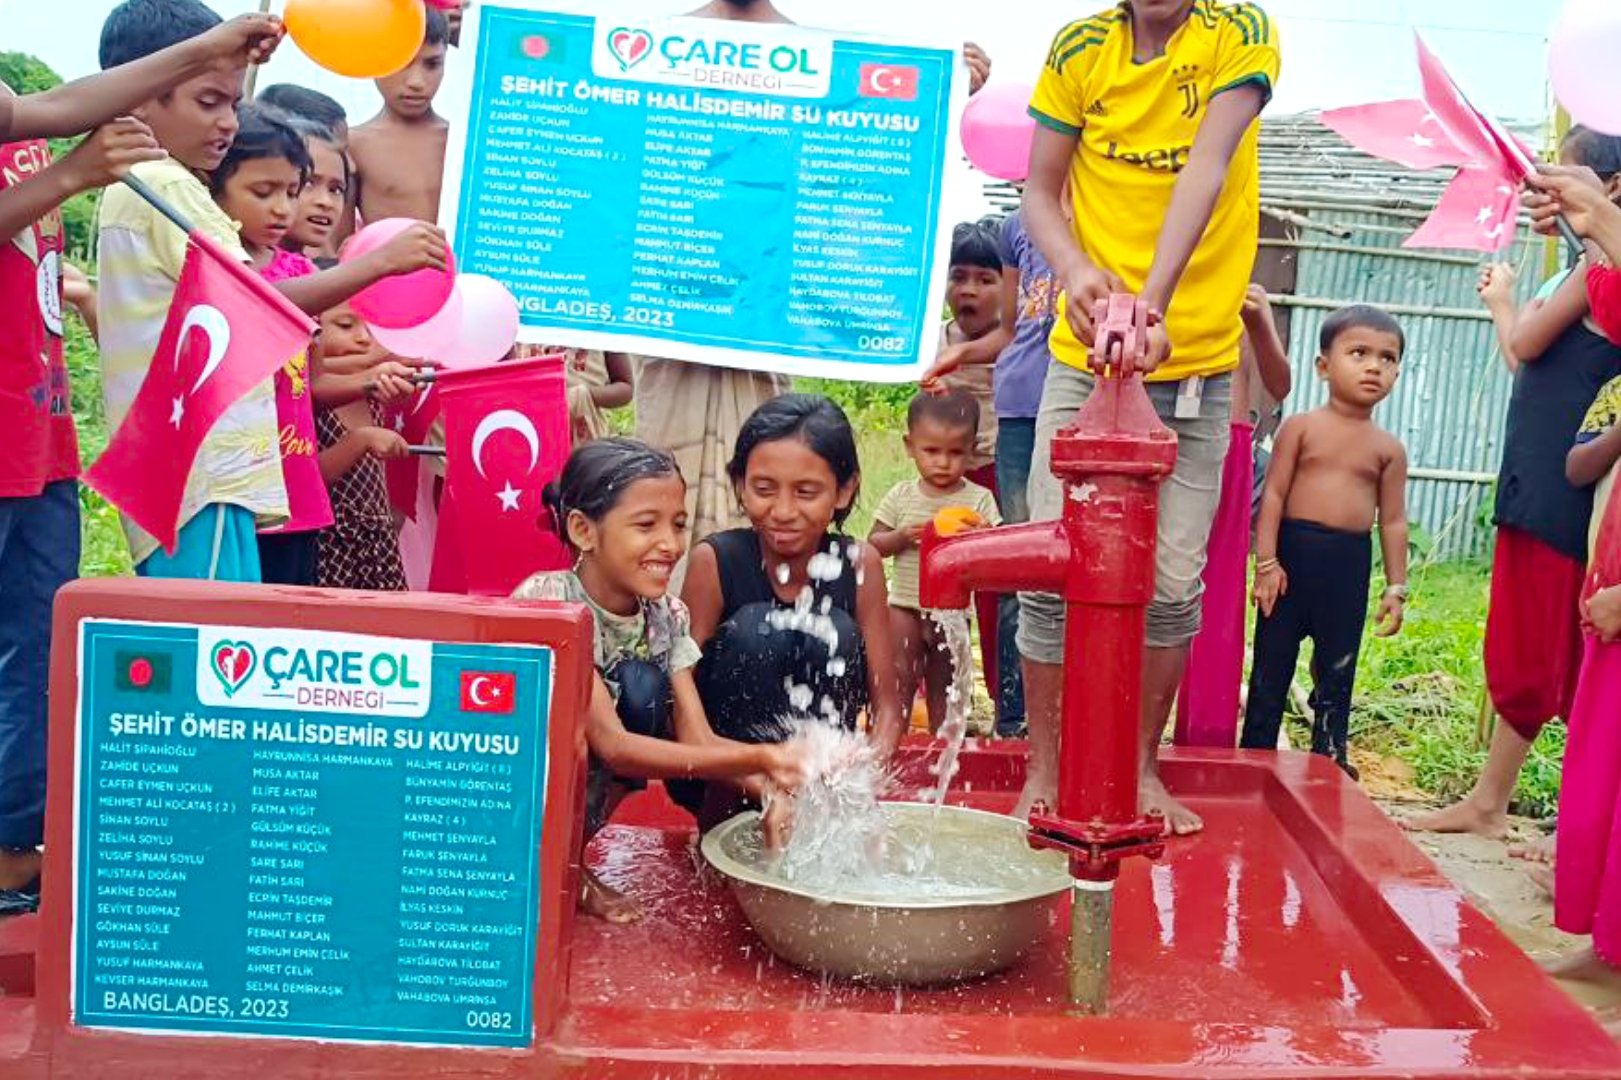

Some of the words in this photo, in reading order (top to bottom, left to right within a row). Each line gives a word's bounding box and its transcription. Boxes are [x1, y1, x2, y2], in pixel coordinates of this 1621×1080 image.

[660, 36, 762, 69] ÇARE
[769, 46, 818, 75] OL
[501, 74, 568, 97] ŞEHİT
[573, 81, 640, 106] ÖMER
[647, 89, 785, 121] HALİSDEMİR
[790, 105, 821, 124] SU
[826, 111, 920, 132] KUYUSU
[518, 296, 617, 323] NGLADEŞ,
[623, 306, 675, 327] 2023
[858, 335, 905, 351] 0082
[263, 646, 363, 689] ÇARE
[369, 652, 420, 688] OL
[109, 711, 175, 736] ŞEHİT
[181, 713, 246, 740] ÖMER
[253, 718, 388, 748] HALİSDEMİR
[394, 730, 423, 749] SU
[429, 730, 520, 755] KUYUSU
[322, 754, 393, 767] HARMANKAYA
[253, 768, 282, 779] MUSA
[284, 770, 319, 780] AKTAR
[99, 778, 135, 789] CAFER
[137, 779, 173, 791] EYMEN
[283, 788, 317, 798] AKTAR
[99, 796, 142, 808] MEHMET
[145, 797, 162, 808] ALİ
[251, 803, 286, 815] FATMA
[134, 816, 169, 826] SOYLU
[404, 813, 444, 824] KAYRAZ
[138, 834, 173, 845] SOYLU
[403, 831, 444, 842] MEHMET
[99, 850, 133, 860] YUSUF
[170, 853, 205, 864] SOYLU
[402, 850, 435, 860] FARUK
[250, 857, 277, 868] SARE
[280, 858, 304, 870] SARI
[98, 868, 145, 878] MUSTAFA
[402, 866, 434, 877] FATMA
[280, 877, 304, 887] SARI
[136, 905, 180, 917] DURMAZ
[248, 910, 293, 922] MAHMUT
[400, 920, 432, 930] YUSUF
[247, 927, 287, 940] FERHAT
[290, 929, 330, 941] KAPLAN
[96, 939, 130, 949] AYSUN
[399, 938, 436, 948] SULTAN
[246, 946, 291, 956] MERHUM
[96, 956, 129, 967] YUSUF
[133, 959, 204, 971] HARMANKAYA
[246, 964, 282, 975] AHMET
[95, 974, 134, 985] KEVSER
[137, 977, 209, 988] HARMANKAYA
[246, 981, 279, 992] SELMA
[104, 991, 234, 1017] BANGLADEŞ,
[240, 997, 290, 1018] 2023
[467, 1010, 512, 1029] 0082
